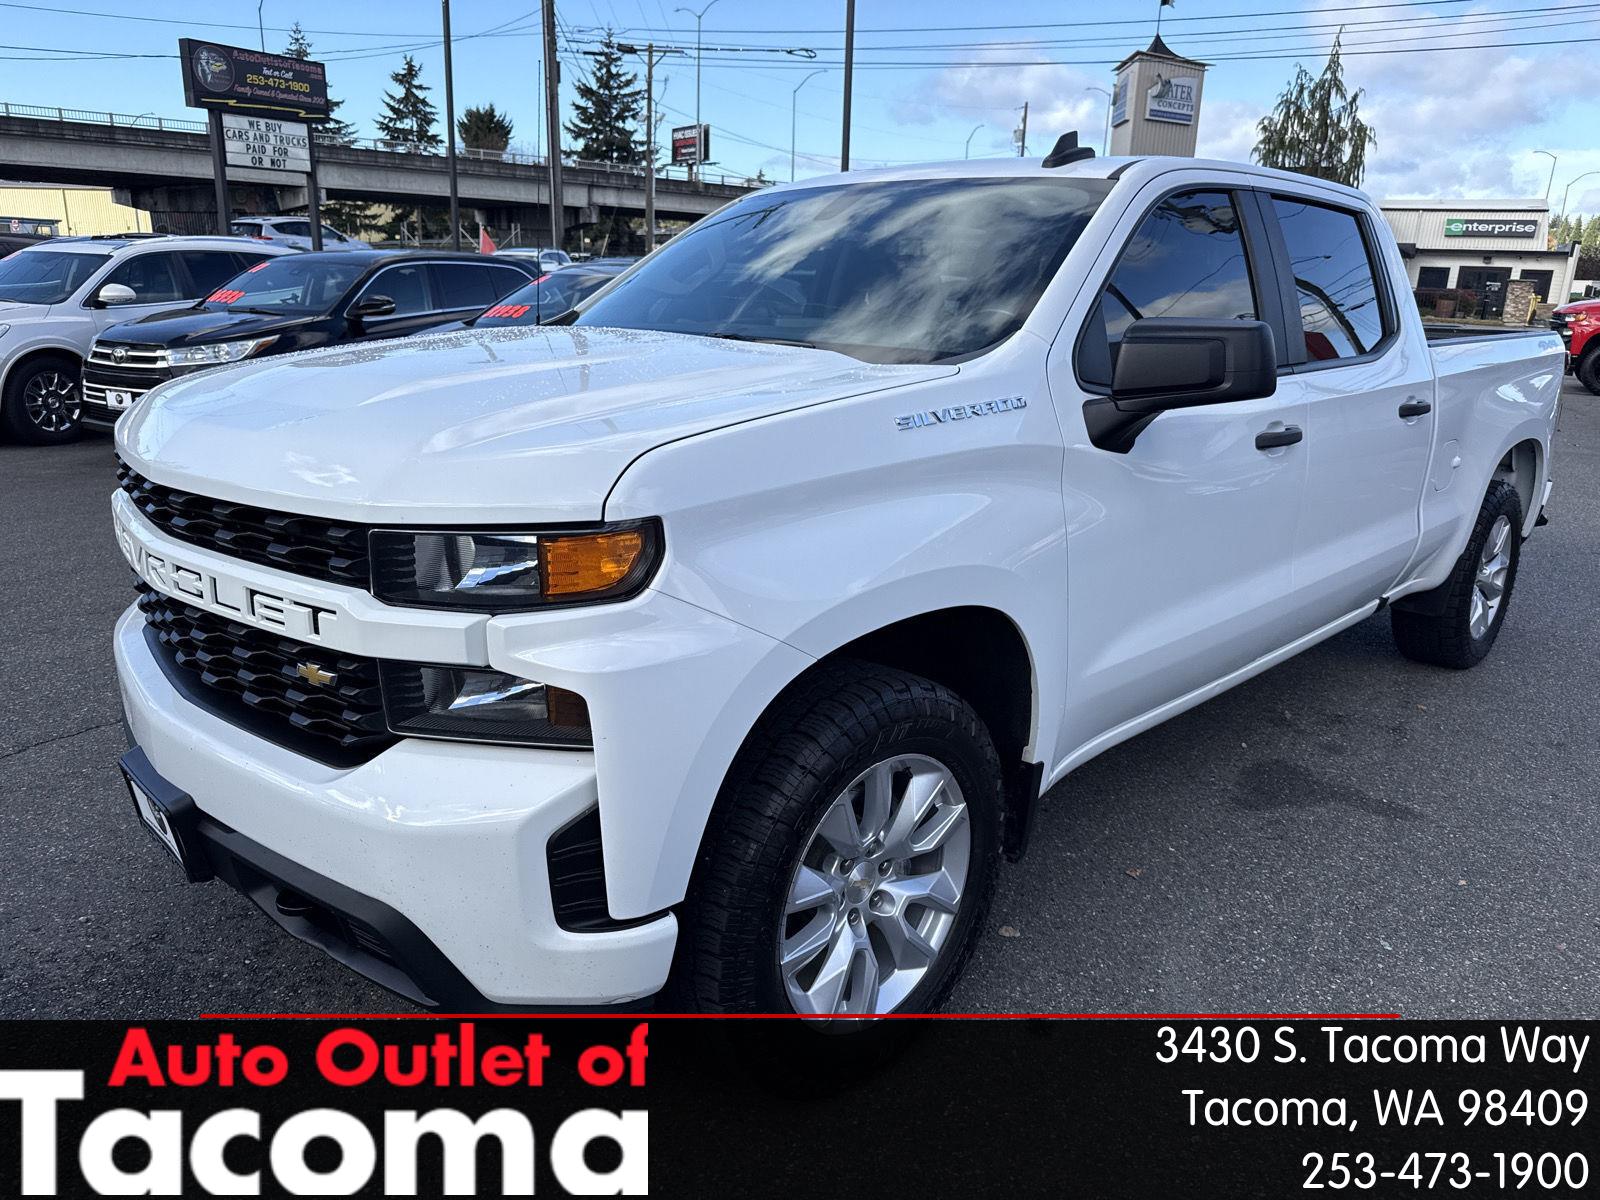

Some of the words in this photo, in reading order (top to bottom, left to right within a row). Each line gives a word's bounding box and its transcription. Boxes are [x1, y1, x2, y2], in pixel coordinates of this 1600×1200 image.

[246, 74, 310, 93] 253-473-1900
[1157, 100, 1194, 112] CONCEPTS
[248, 119, 261, 131] WE
[265, 121, 282, 133] BUY
[225, 129, 250, 141] CARS
[253, 132, 270, 143] AND
[273, 135, 307, 147] TRUCKS
[246, 143, 266, 155] PAID
[273, 146, 289, 157] FOR
[251, 156, 264, 166] OR
[270, 158, 287, 168] NOT
[1450, 222, 1536, 234] enterprise
[895, 396, 1027, 431] SILVERADO
